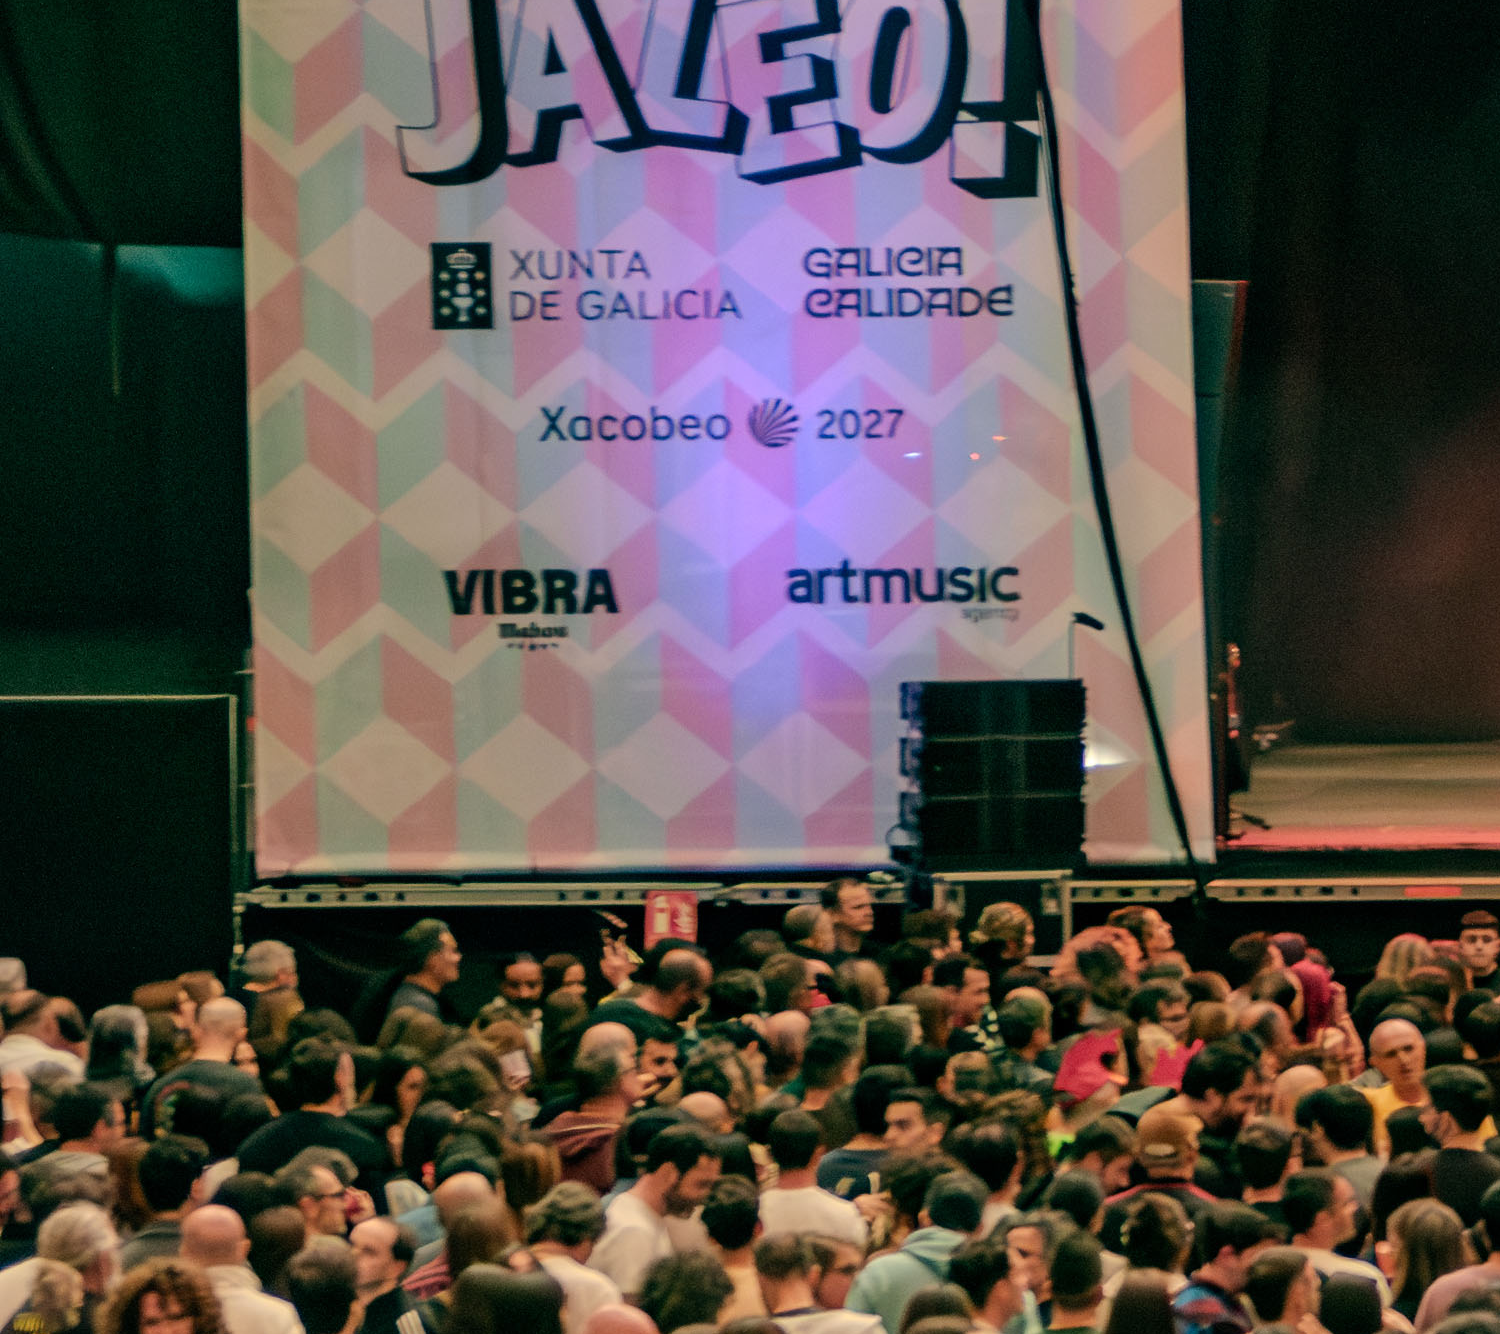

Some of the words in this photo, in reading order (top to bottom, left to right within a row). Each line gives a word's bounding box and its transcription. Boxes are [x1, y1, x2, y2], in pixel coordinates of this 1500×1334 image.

[508, 249, 652, 281] XUNTA
[802, 246, 964, 277] GALICIA
[508, 290, 563, 321] DE
[576, 290, 743, 321] GALICIA
[805, 283, 1015, 318] CALIDADE
[538, 405, 732, 441] Xacobeo
[816, 409, 905, 441] 2027
[443, 569, 619, 614] VIBRA
[787, 559, 1020, 604] artmusic
